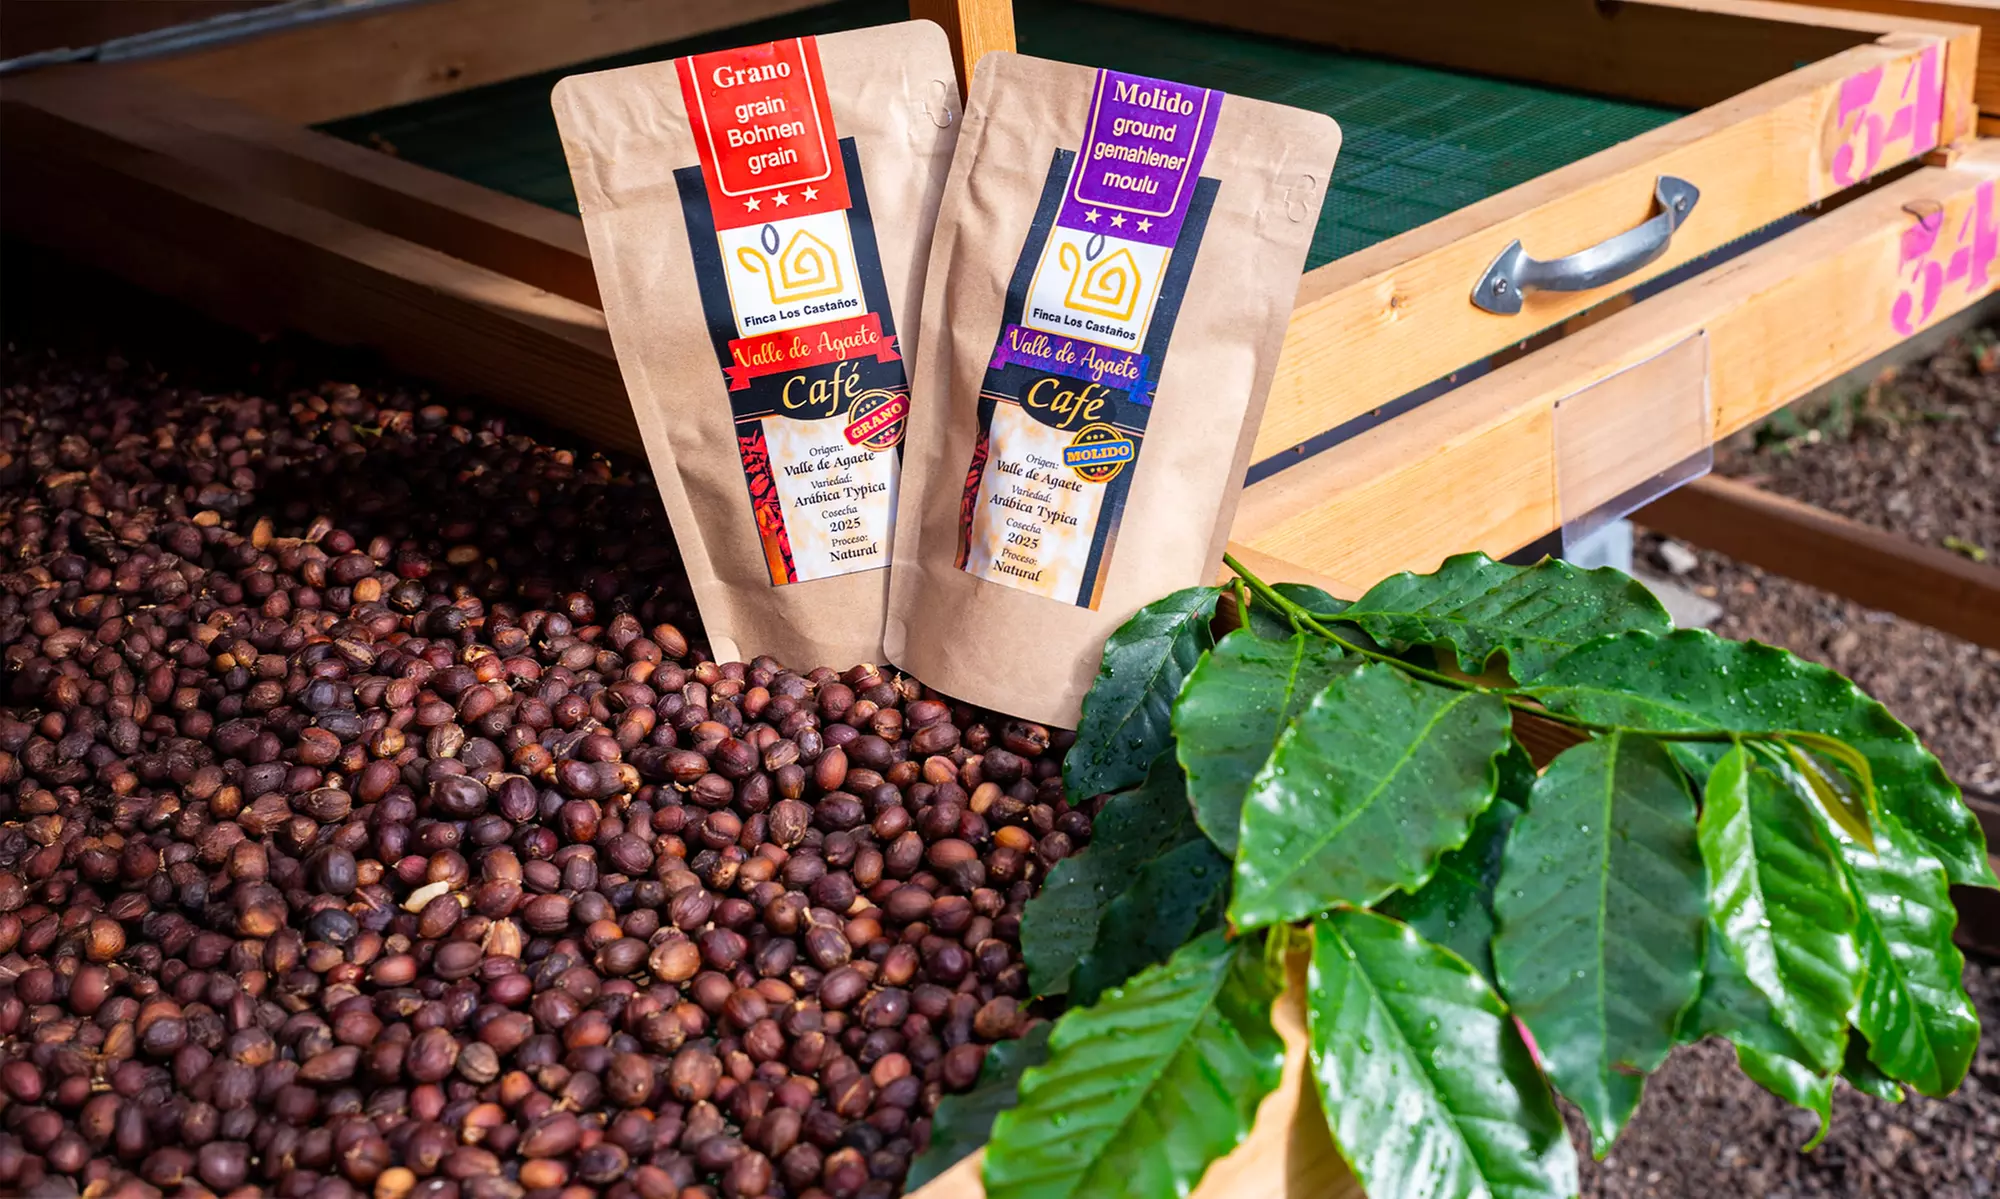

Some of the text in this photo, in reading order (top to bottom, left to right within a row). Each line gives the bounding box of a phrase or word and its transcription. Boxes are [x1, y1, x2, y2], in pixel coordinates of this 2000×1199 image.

[712, 61, 791, 88] Grano
[735, 96, 786, 124] grain
[1112, 80, 1194, 116] Molido
[1831, 43, 1941, 187] 34
[726, 121, 805, 148] Bohnen
[1112, 117, 1177, 143] ground
[747, 147, 798, 175] grain
[1093, 141, 1186, 171] gemahlener
[1102, 171, 1159, 195] moulu
[744, 298, 858, 328] Finca Los Castaños
[1032, 307, 1137, 341] Finca Los Castaños
[733, 323, 880, 368] Valle de Agaete
[1009, 328, 1140, 382] Valle de Agaete
[782, 361, 864, 417] Café
[1027, 378, 1111, 429] Café
[851, 401, 903, 440] GRANO
[783, 451, 876, 477] Valle de Agaete
[808, 444, 844, 458] Origen:
[1025, 453, 1060, 470] Origen:
[1066, 445, 1130, 463] MOLIDO
[810, 474, 853, 489] Variedad:
[996, 460, 1083, 493] Valle de Agaete
[794, 481, 887, 508] Arábica Typica
[1011, 484, 1052, 504] Variedad:
[821, 505, 858, 519] Cosecha
[989, 493, 1079, 527] Arábica Typica
[829, 517, 861, 533] 2025
[1005, 517, 1042, 535] Cosecha
[829, 542, 878, 563] Natural
[831, 534, 868, 548] Proceso:
[1006, 532, 1040, 550] 2025
[1000, 547, 1038, 566] Proceso:
[992, 559, 1043, 583] Natural
